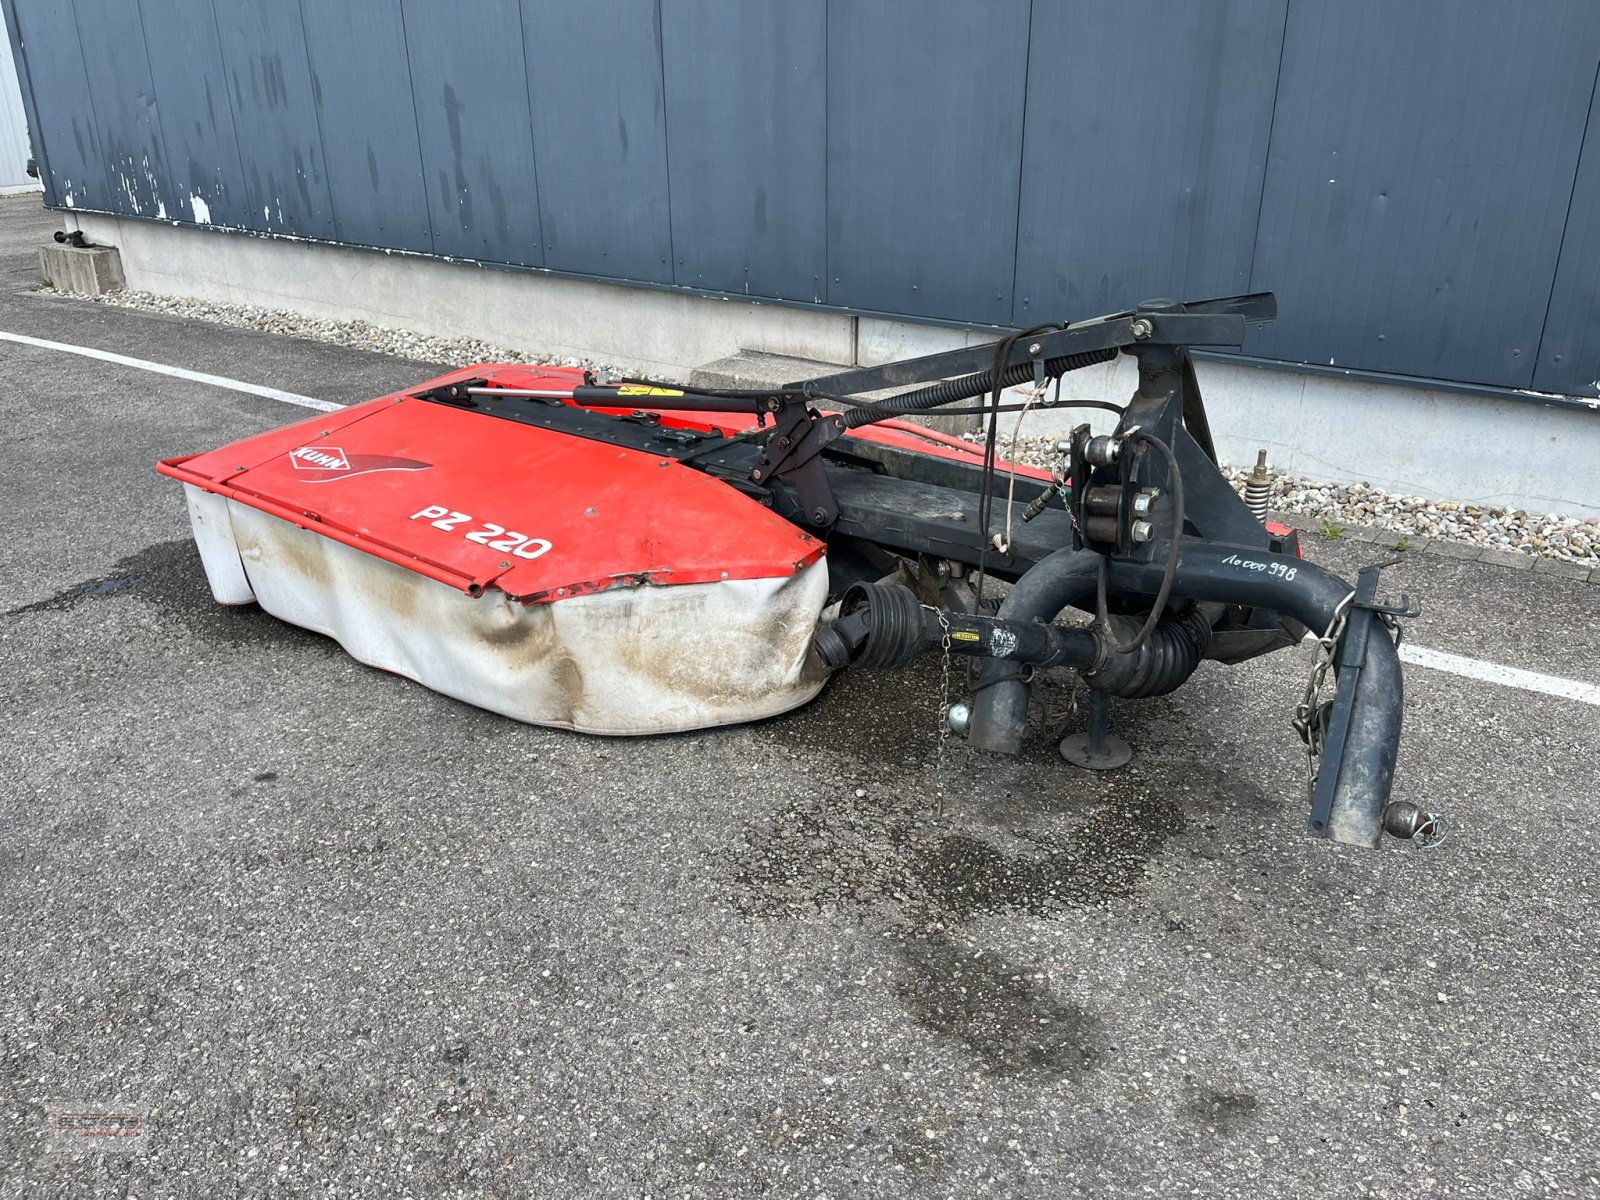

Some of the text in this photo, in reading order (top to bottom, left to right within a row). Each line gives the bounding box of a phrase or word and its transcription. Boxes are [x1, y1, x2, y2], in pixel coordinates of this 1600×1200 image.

[292, 447, 345, 469] KUHN
[409, 504, 553, 560] PZ 220
